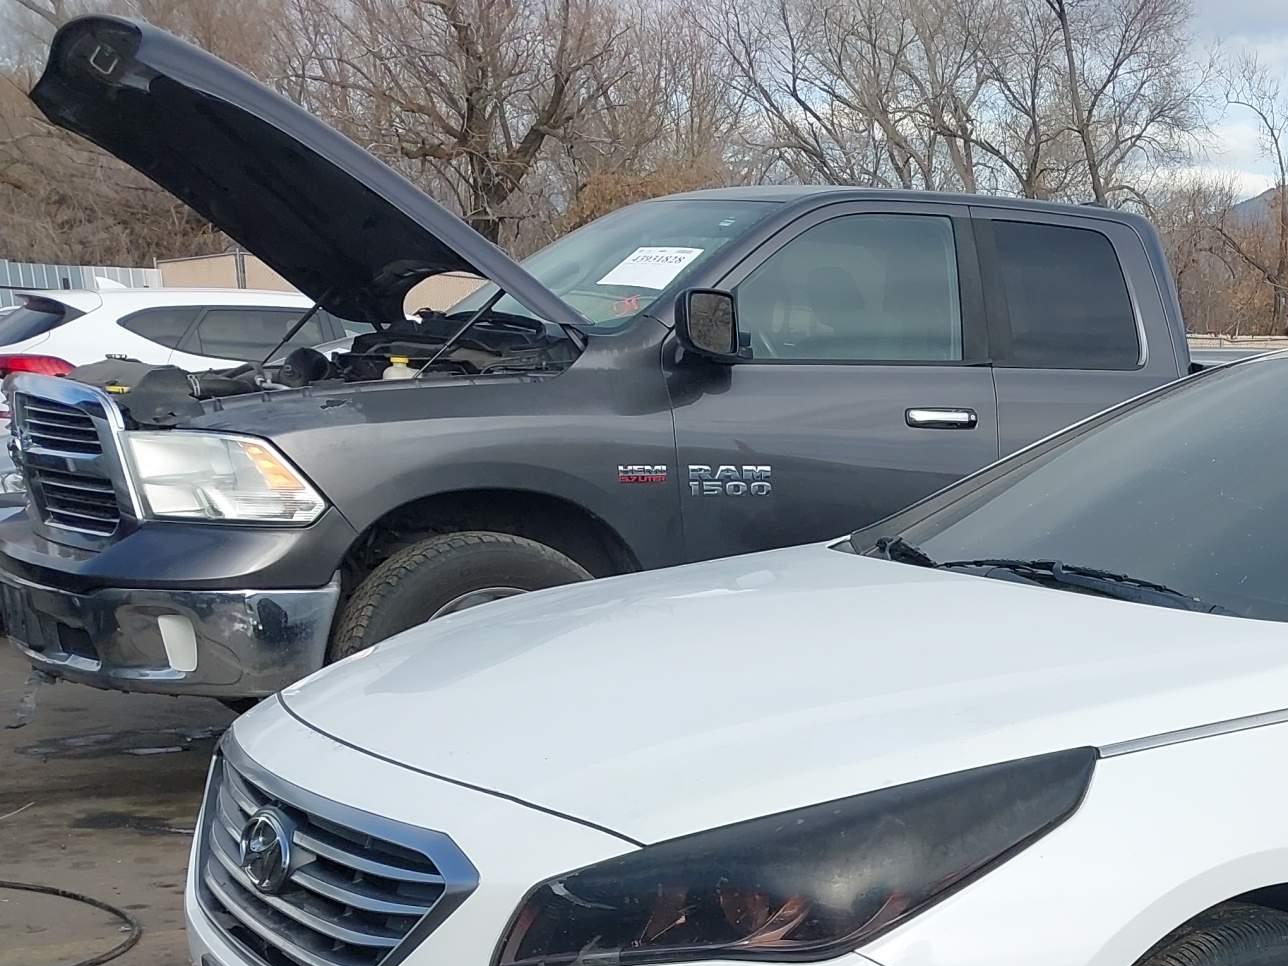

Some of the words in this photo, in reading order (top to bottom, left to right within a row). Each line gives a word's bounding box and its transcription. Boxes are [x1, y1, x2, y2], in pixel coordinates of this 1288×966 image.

[618, 465, 667, 476] HEMI
[688, 465, 772, 480] RAM
[689, 481, 772, 497] 1500
